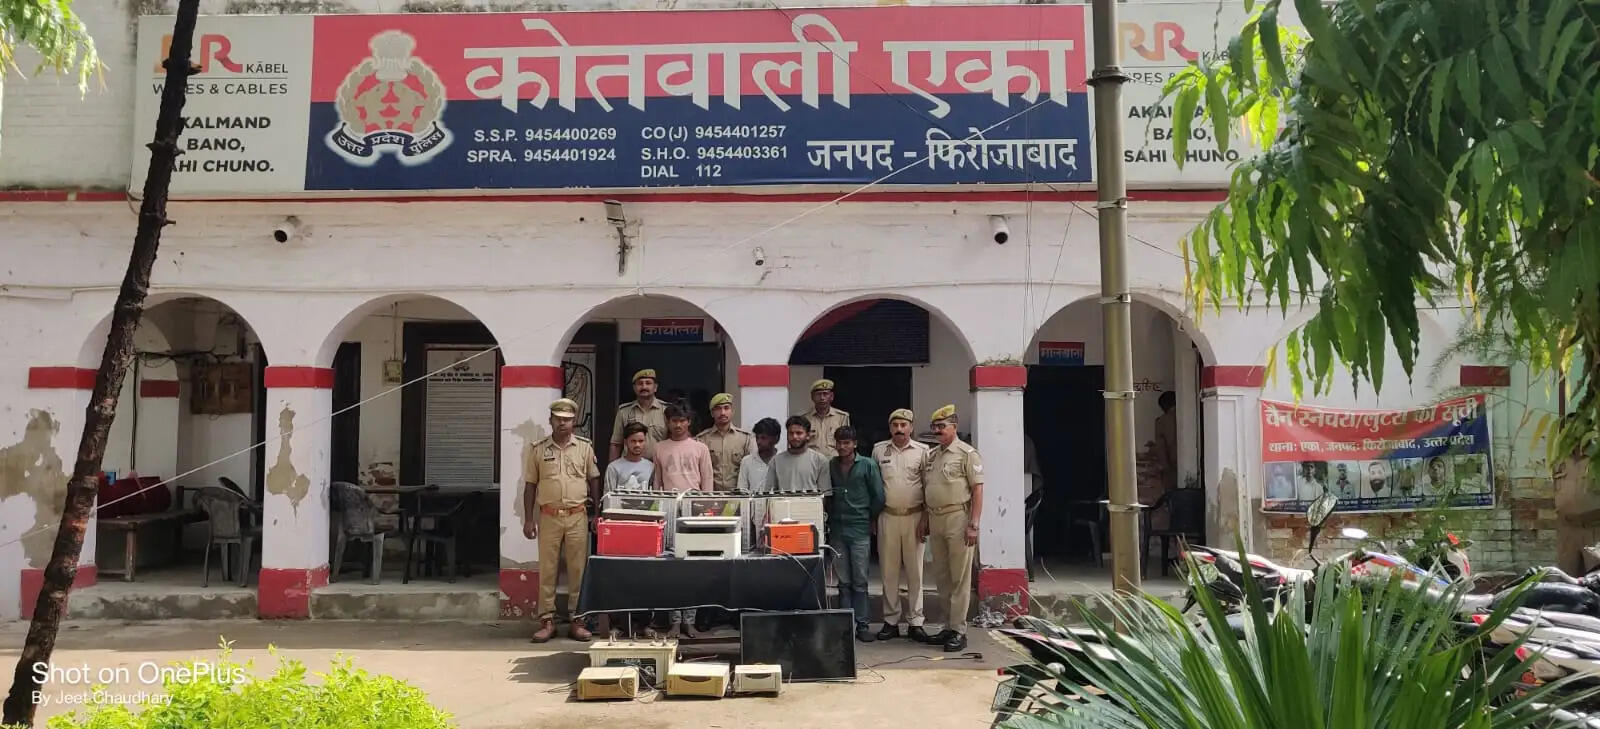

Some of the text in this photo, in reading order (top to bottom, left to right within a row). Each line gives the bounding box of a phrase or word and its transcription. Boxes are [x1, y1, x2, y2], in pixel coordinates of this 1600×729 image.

[464, 14, 1074, 119] कोतवाली एका
[152, 83, 288, 95] WES & CABLES
[180, 116, 271, 129] KALMAND
[474, 128, 617, 142] S.S.P. 9454400269
[695, 125, 786, 139] 9454401257
[187, 138, 246, 152] BANO,
[807, 140, 894, 171] जनपद
[926, 128, 1078, 171] फिरोजाबाद
[466, 148, 616, 163] SPRA. 9454401924
[641, 146, 788, 160] S.H.O. 9454403361
[1124, 149, 1167, 162] SAHI
[171, 159, 275, 172] AHI CHUNO.
[641, 164, 722, 178] DIAL 112
